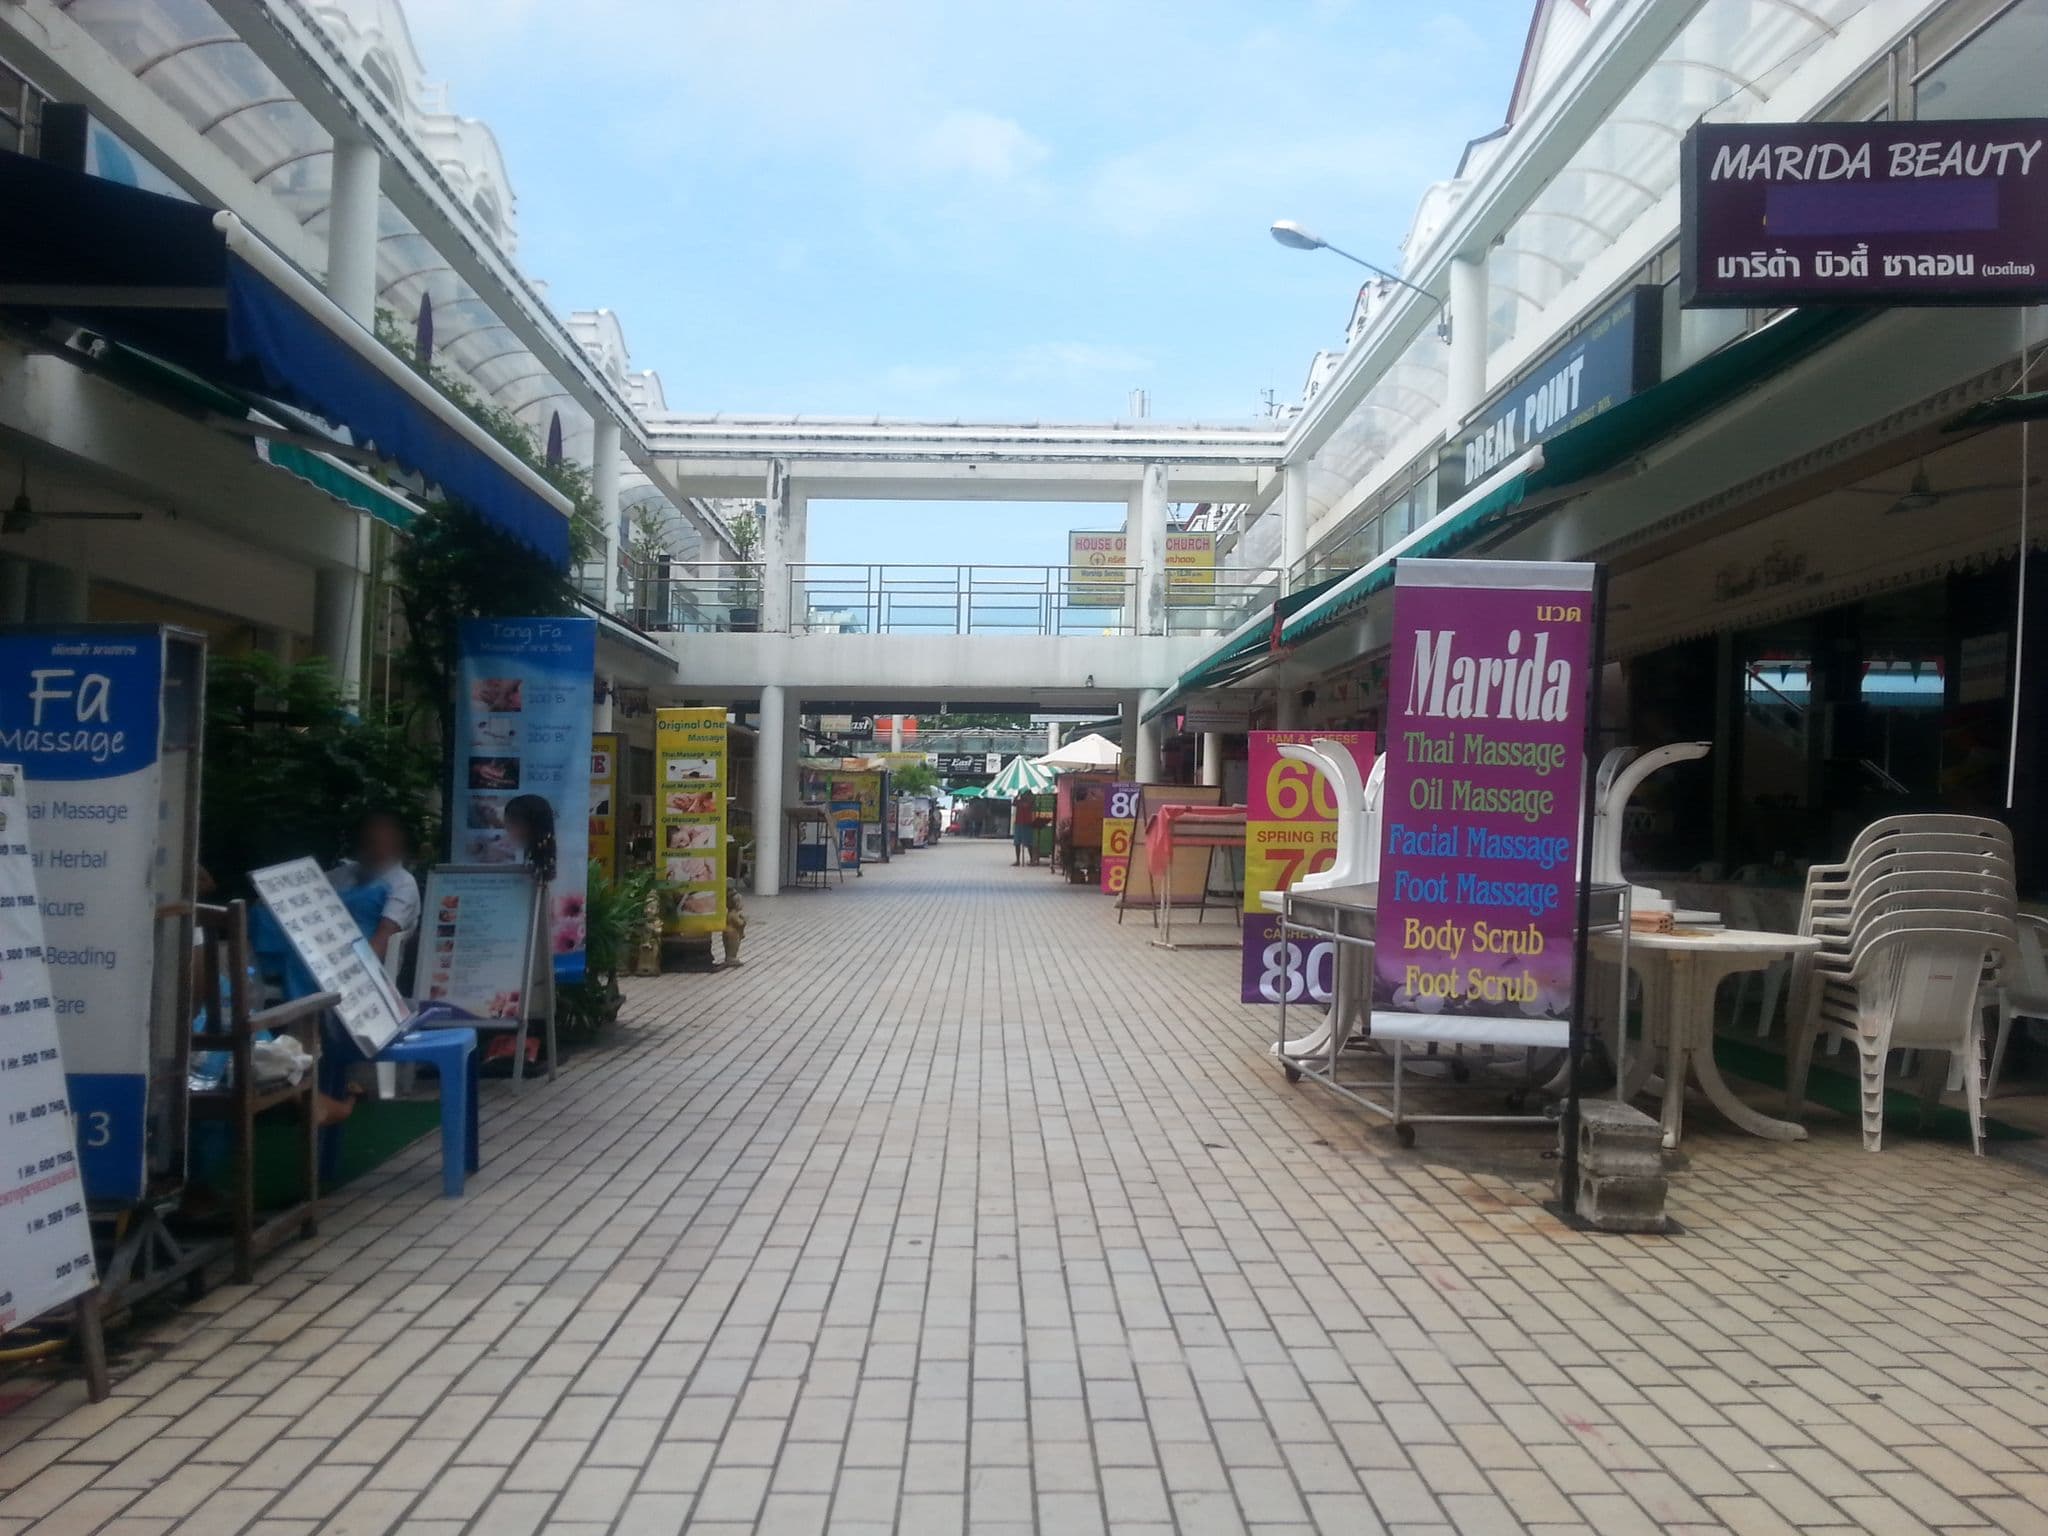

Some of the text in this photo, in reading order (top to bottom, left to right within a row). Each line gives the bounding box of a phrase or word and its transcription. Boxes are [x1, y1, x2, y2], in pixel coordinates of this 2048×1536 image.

[1710, 140, 2042, 181] MARIDA BEAUTY
[1464, 407, 1517, 486] BREAK
[1524, 354, 1585, 444] POINT
[1075, 537, 1113, 551] HOUSE
[1165, 537, 1211, 551] CHURCH
[1536, 605, 1582, 623] นวด
[1404, 628, 1571, 722] Marida
[28, 668, 113, 726] Fa
[658, 720, 726, 732] Original One
[687, 734, 725, 744] Massage
[1267, 734, 1294, 744] HAM
[1298, 734, 1306, 744] &
[951, 758, 973, 767] East
[1403, 731, 1566, 776] Thai Massage
[52, 802, 129, 823] Massage
[1409, 778, 1554, 823] Oil Massage
[1256, 830, 1315, 844] SPRING
[1388, 823, 1570, 870] Facial Massage
[50, 850, 108, 869] Herbal
[1393, 870, 1559, 916] Foot Massage
[1403, 917, 1545, 960] Body Scrub
[47, 947, 117, 969] Beading
[1404, 964, 1540, 1003] Foot Scrub
[87, 1111, 111, 1147] 3
